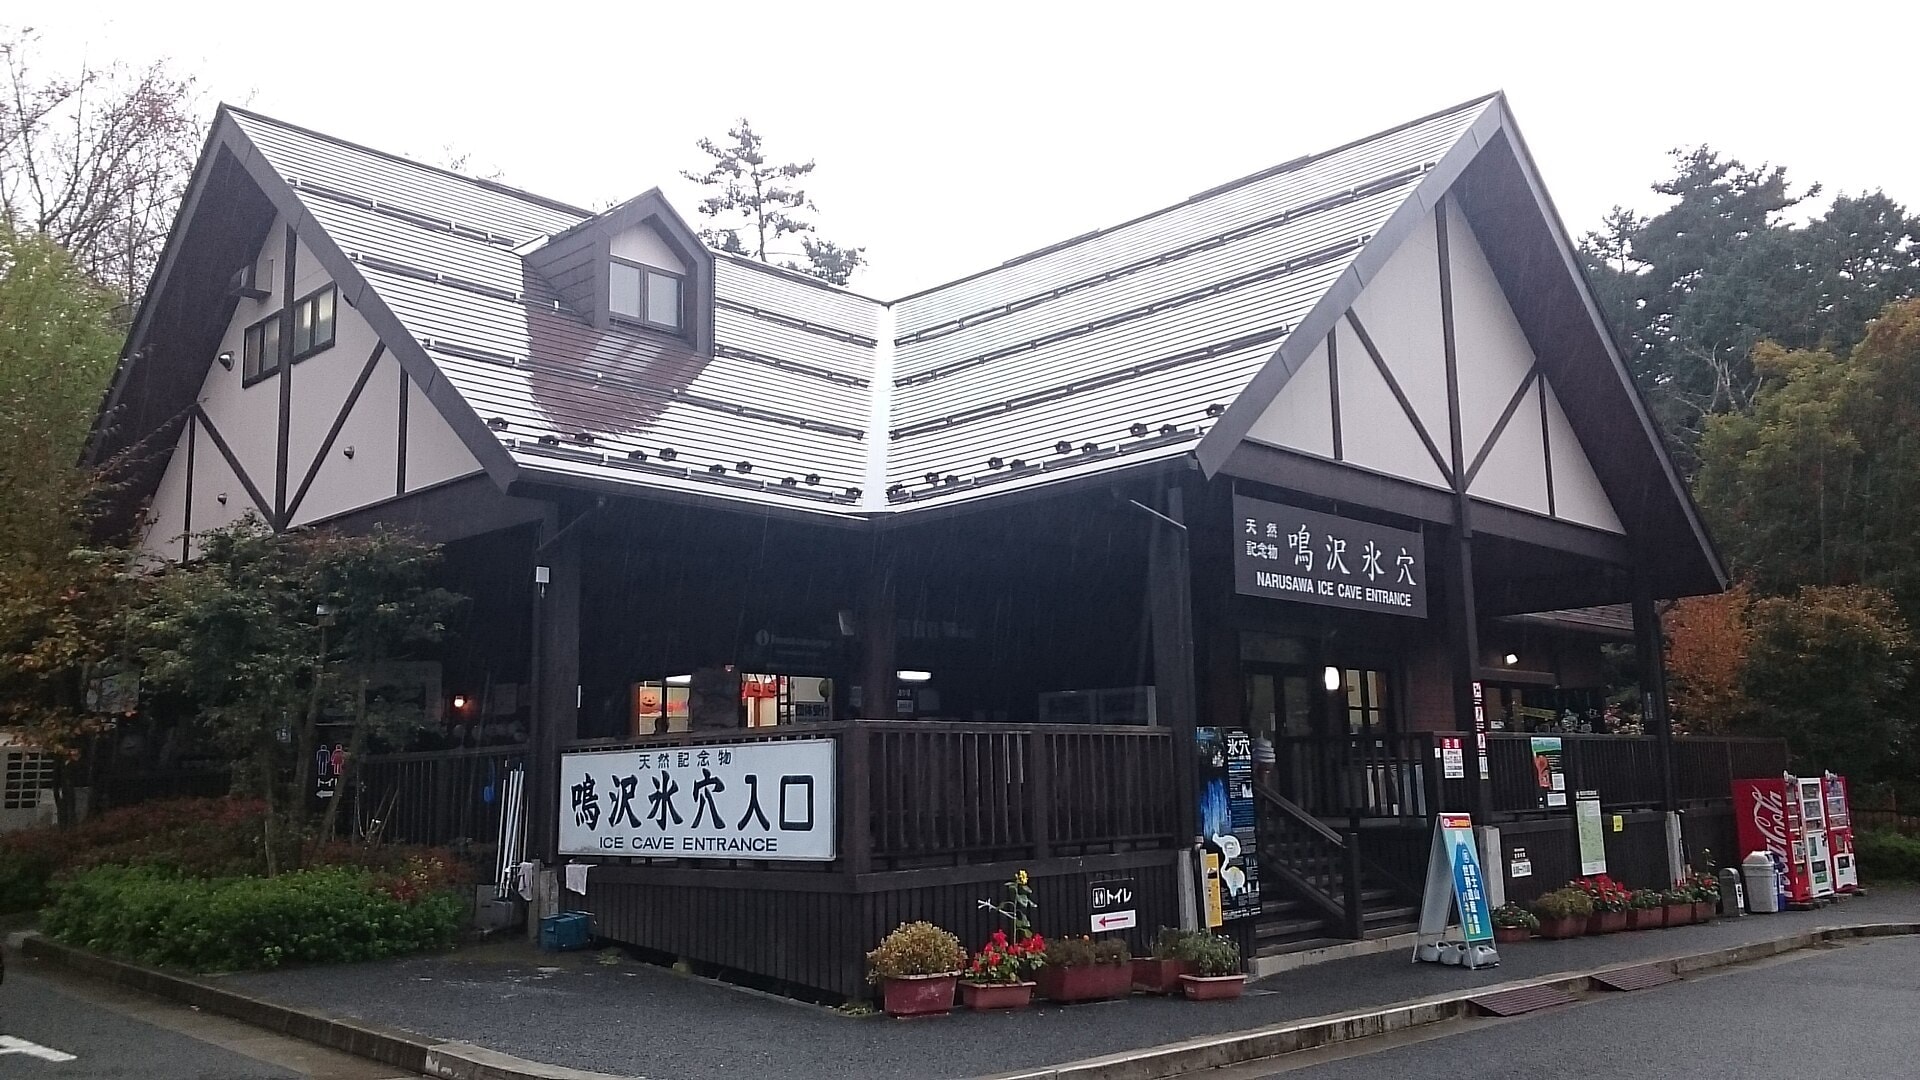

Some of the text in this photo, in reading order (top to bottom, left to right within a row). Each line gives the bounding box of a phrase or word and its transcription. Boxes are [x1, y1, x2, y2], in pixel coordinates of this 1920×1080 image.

[1245, 518, 1278, 539] 天然
[1245, 540, 1278, 560] 記念物
[1287, 523, 1417, 586] 鳴沢氷穴
[1256, 571, 1412, 607] NARUSAWA ICE CAVE ENTRANCE
[1227, 738, 1251, 755] 氷穴
[638, 750, 733, 770] 天然記念物
[571, 768, 815, 832] 鳴沢氷穴入口
[599, 836, 778, 852] ICE CAVE ENTRANCE
[1106, 887, 1132, 905] トイレ
